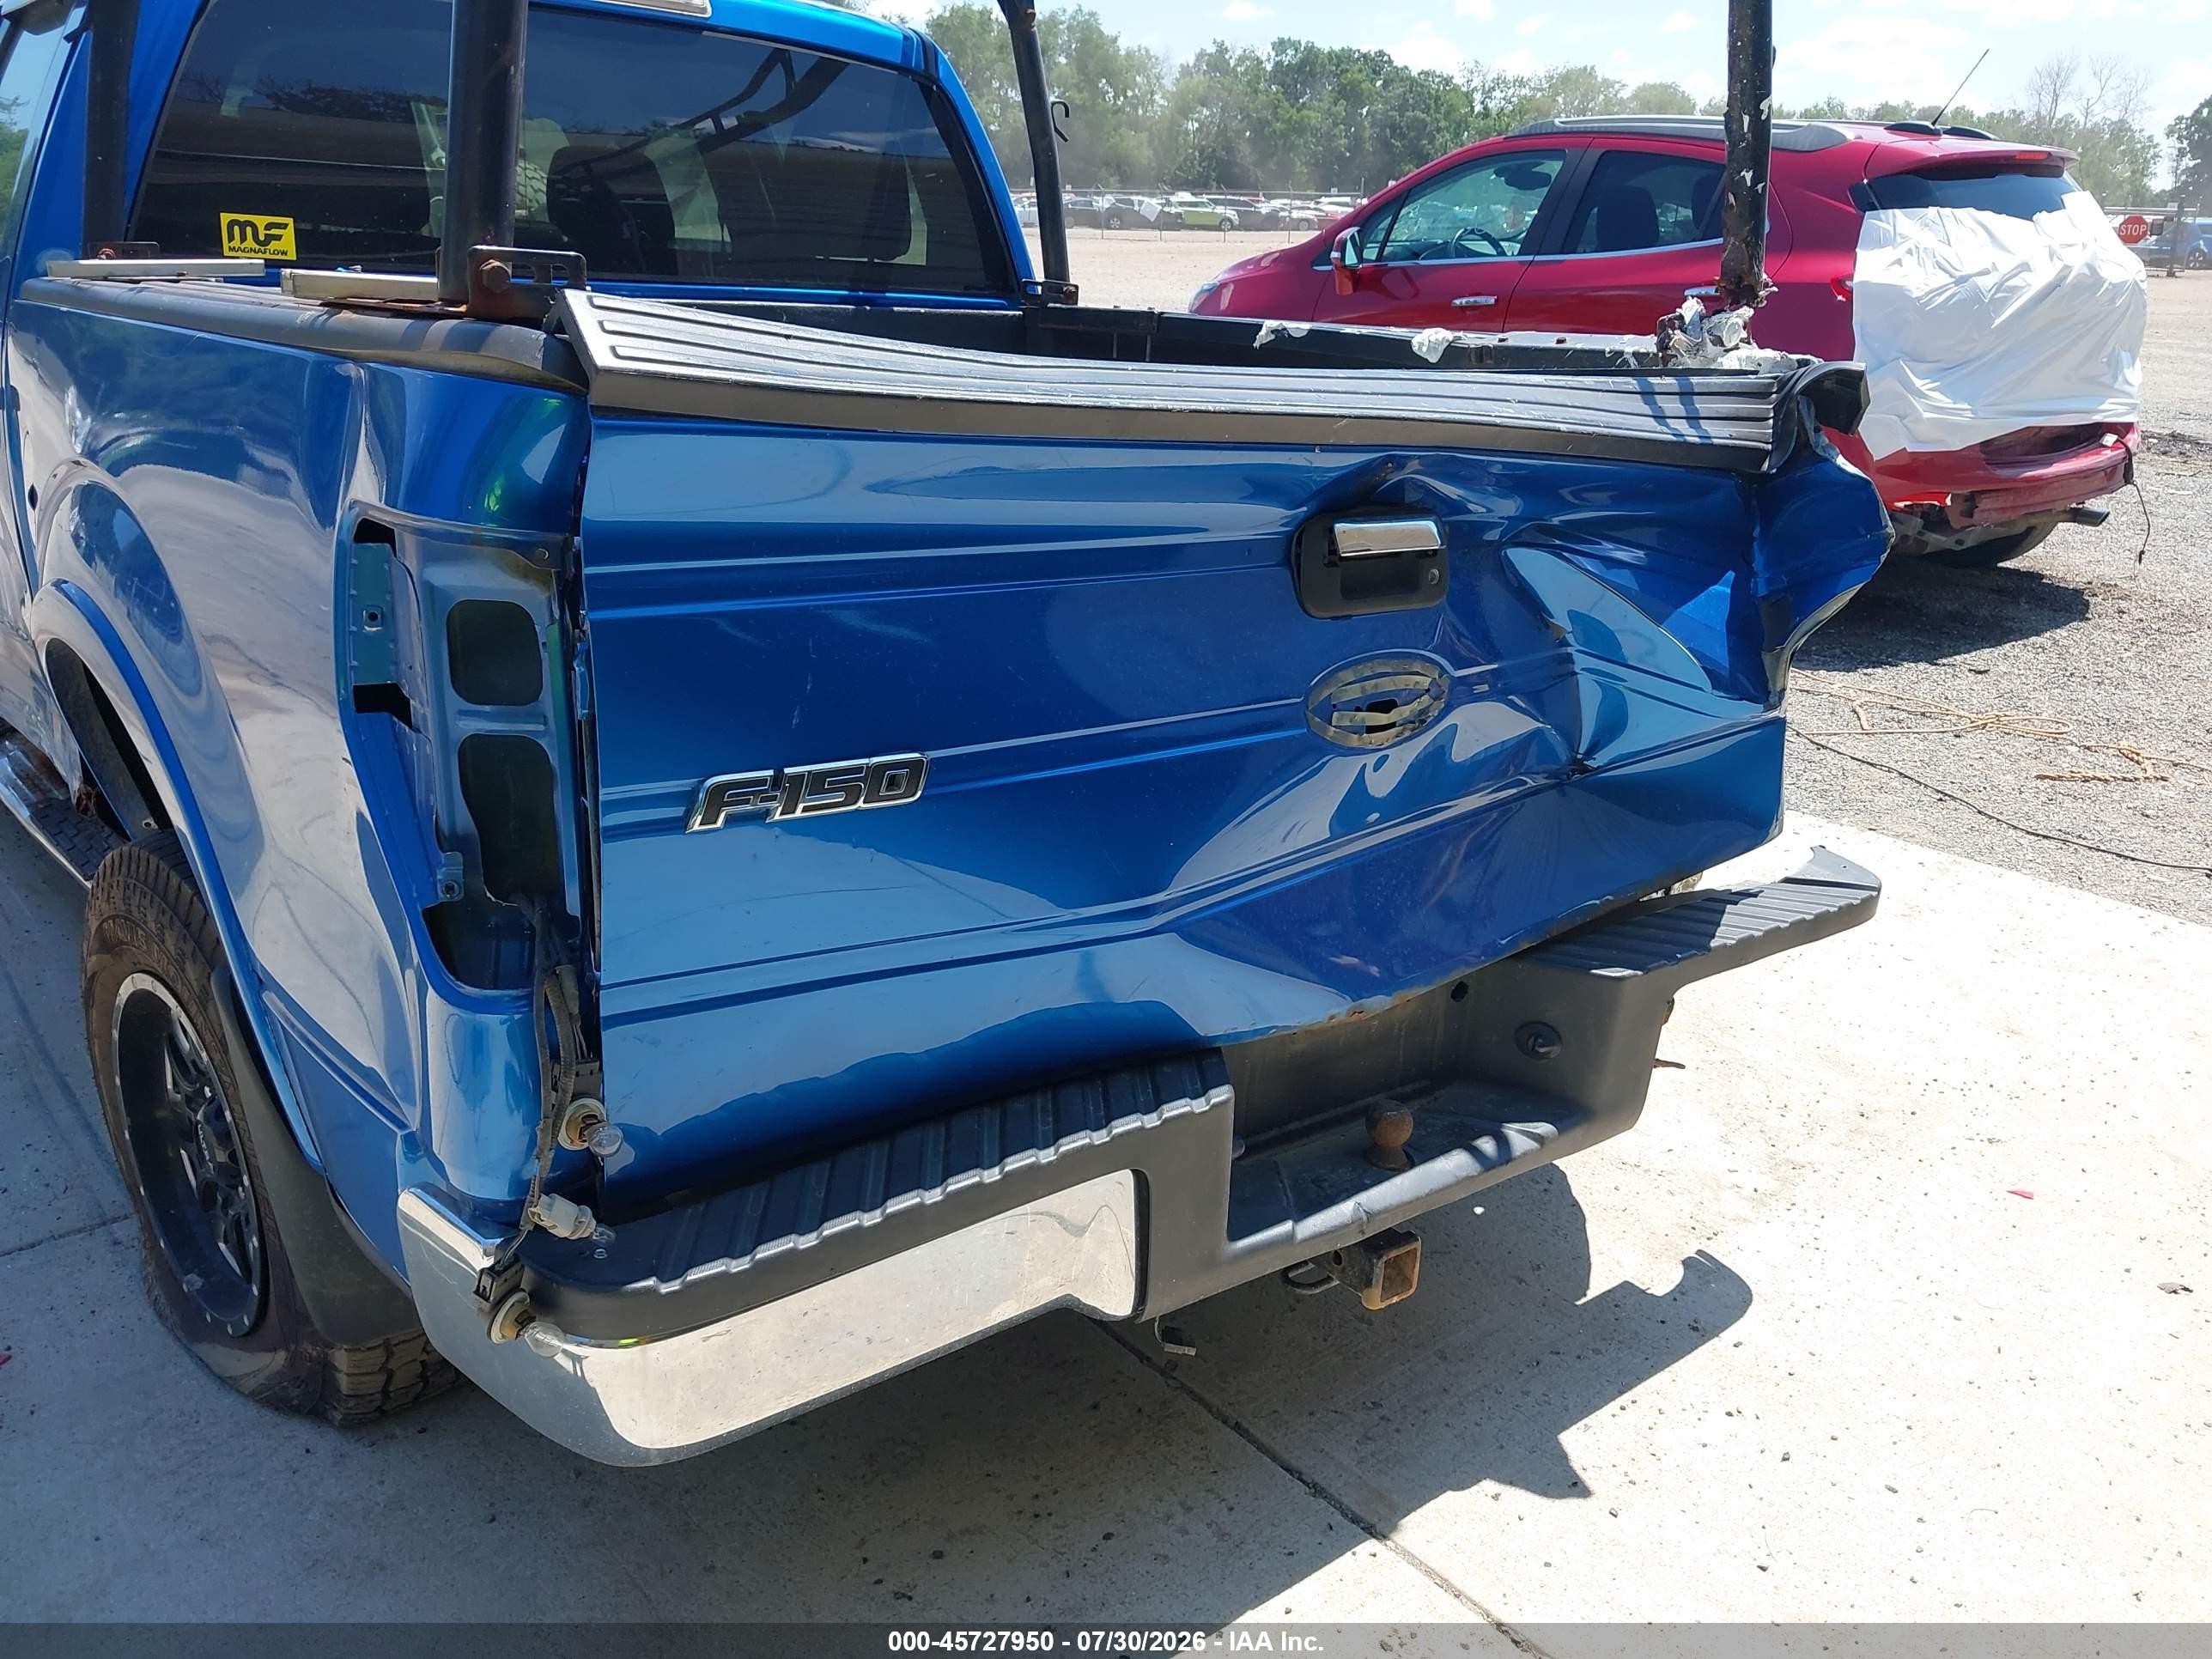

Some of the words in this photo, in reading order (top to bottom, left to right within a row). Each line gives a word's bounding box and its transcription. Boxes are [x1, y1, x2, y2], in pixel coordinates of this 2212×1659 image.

[2120, 224, 2148, 235] STOP
[228, 246, 289, 256] MAGNAFLOW
[686, 752, 928, 833] F-150
